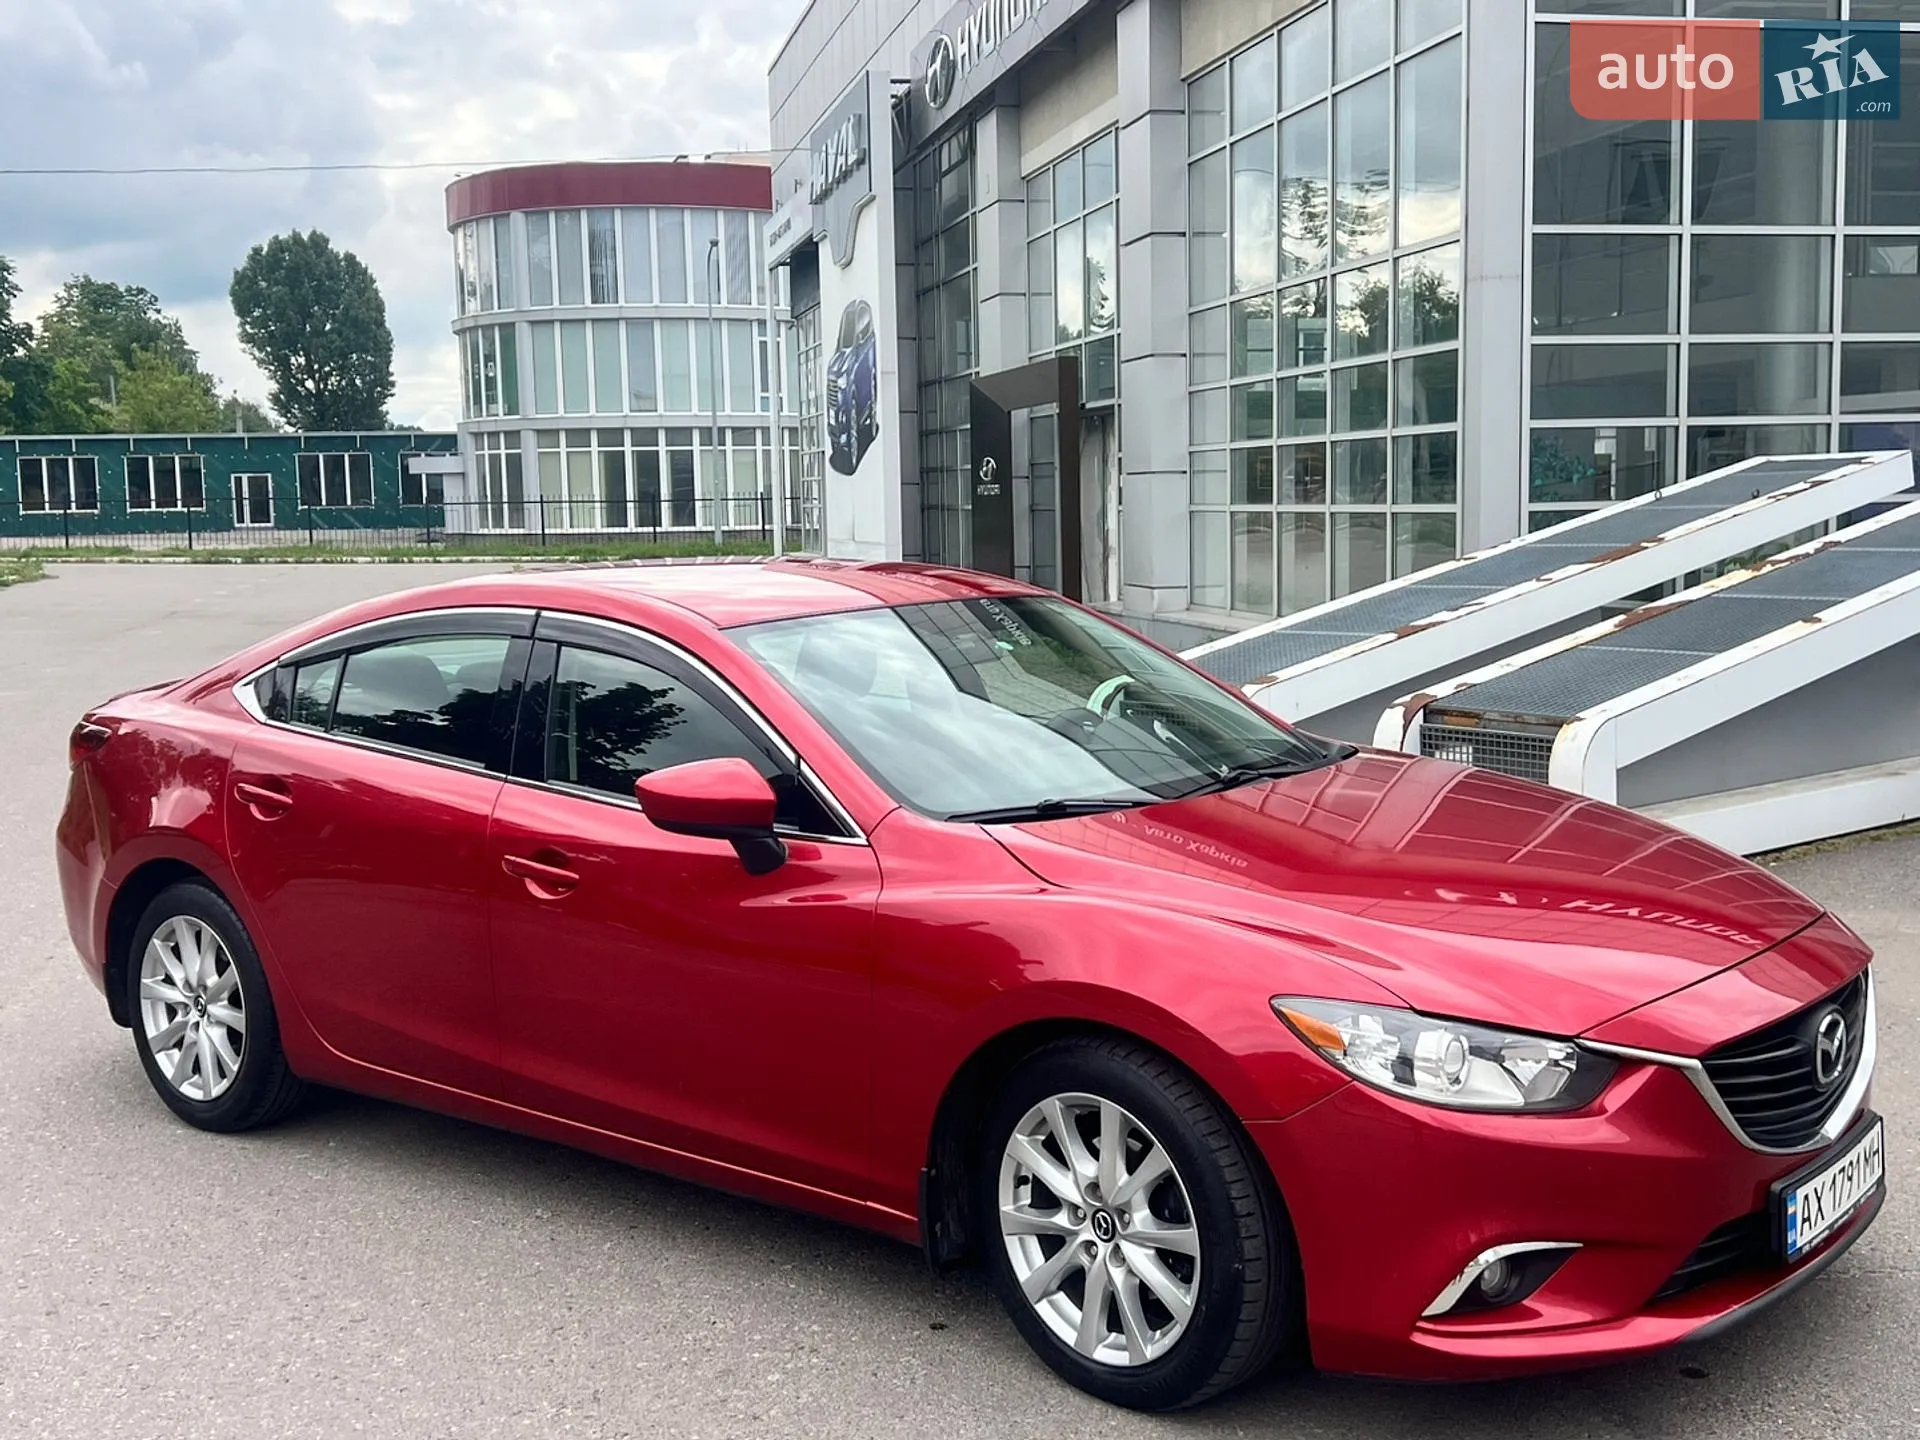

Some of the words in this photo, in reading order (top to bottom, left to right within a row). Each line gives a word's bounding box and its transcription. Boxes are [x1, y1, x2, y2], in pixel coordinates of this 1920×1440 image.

[958, 0, 1048, 80] HYUND
[809, 112, 860, 202] HAVAL
[1800, 1181, 1826, 1237] AX
[1829, 1151, 1861, 1212] 1791
[1863, 1132, 1880, 1184] MH
